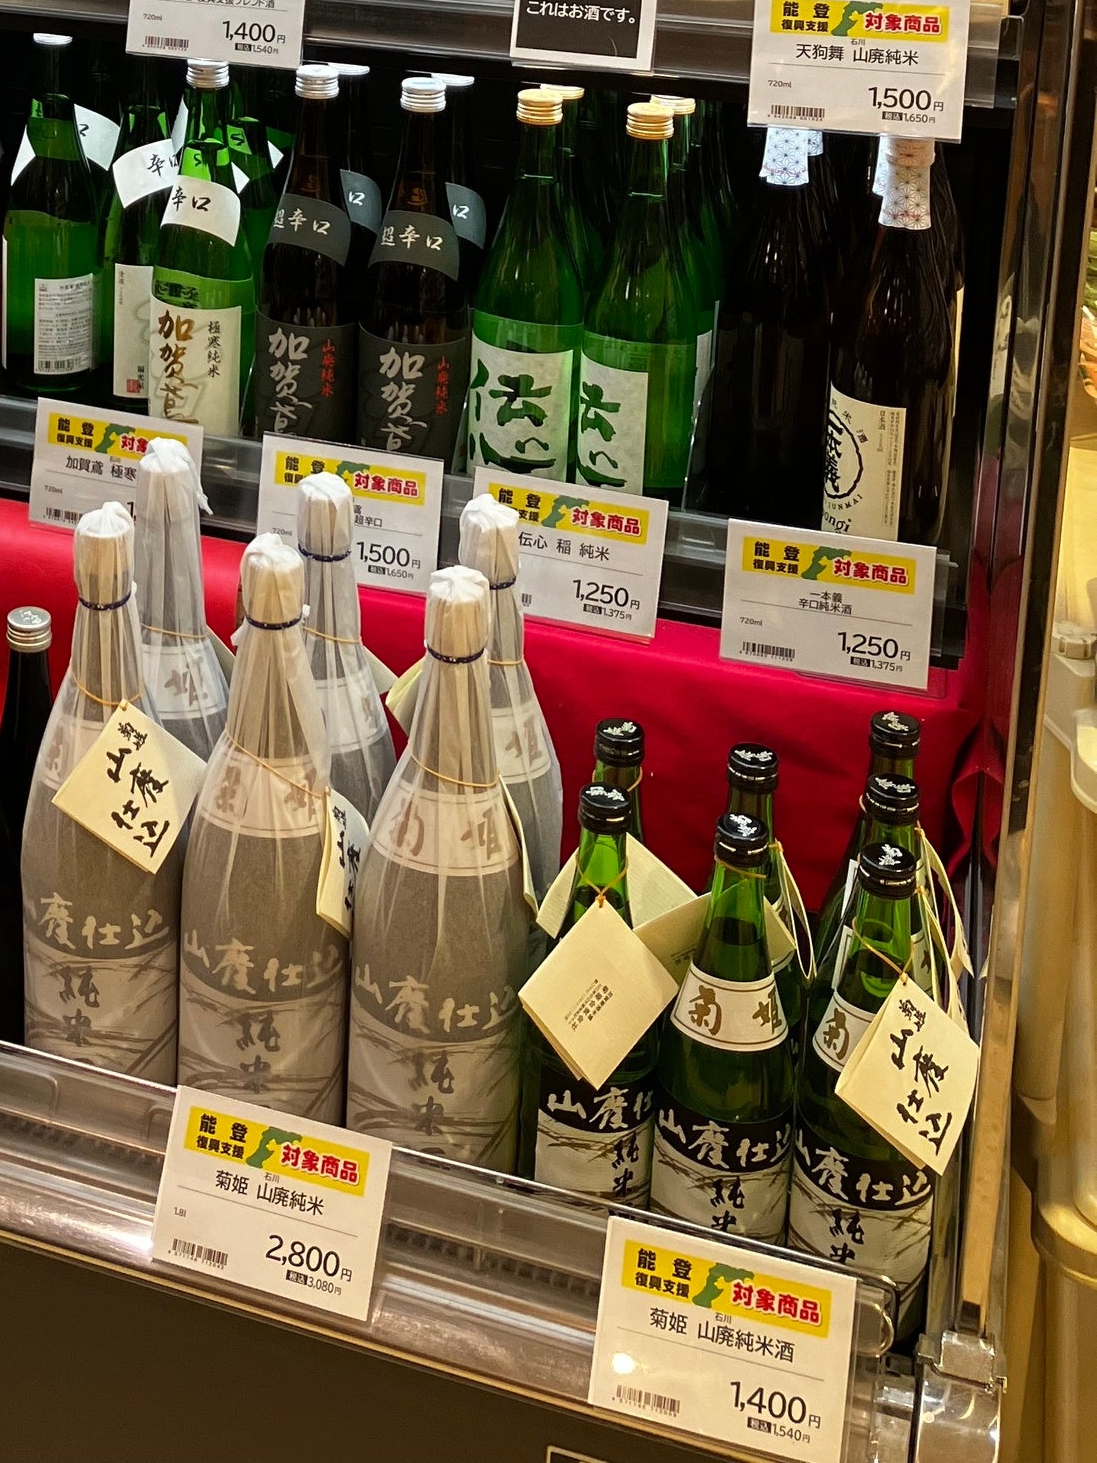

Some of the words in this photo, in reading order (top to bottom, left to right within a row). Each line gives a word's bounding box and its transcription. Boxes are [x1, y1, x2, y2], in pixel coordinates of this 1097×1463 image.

[525, 0, 638, 25] これはお酒です。
[864, 11, 942, 34] 対象商品
[222, 20, 286, 44] 1,400円
[781, 19, 829, 33] 復興支援
[795, 42, 845, 62] 天狗舞
[852, 49, 919, 66] 山廃純米
[768, 79, 792, 88] 720ml
[868, 86, 944, 112] 1,500円
[171, 185, 211, 212] 辛口
[381, 224, 444, 252] 超辛口
[66, 455, 104, 475] 加賀鳶
[354, 472, 418, 497] 対象商品
[356, 541, 421, 569] 1,500円
[518, 531, 548, 550] 伝心
[556, 538, 572, 555] 稲
[579, 542, 610, 561] 純米
[753, 558, 799, 575] 復興支援
[833, 558, 908, 585] 対象商品
[572, 579, 641, 611] 1,250円
[798, 598, 853, 615] 辛口純米酒
[809, 590, 843, 603] 一本義
[739, 616, 763, 626] 720ml
[837, 631, 911, 661] 1,250円
[689, 985, 782, 1037] 菊姫
[196, 1135, 245, 1160] 復興支援
[281, 1144, 358, 1184] 対象商品
[264, 1172, 280, 1184] 石川
[215, 1169, 250, 1196] 菊姫
[256, 1182, 325, 1216] 山廃純米
[265, 1234, 353, 1283] 2,800円
[634, 1271, 691, 1300] 復興支援
[732, 1282, 821, 1324] 対象商品
[714, 1311, 732, 1325] 石川
[649, 1307, 688, 1336] 菊姫
[697, 1320, 796, 1364] 山廃純米酒
[729, 1380, 822, 1430] 1,400円
